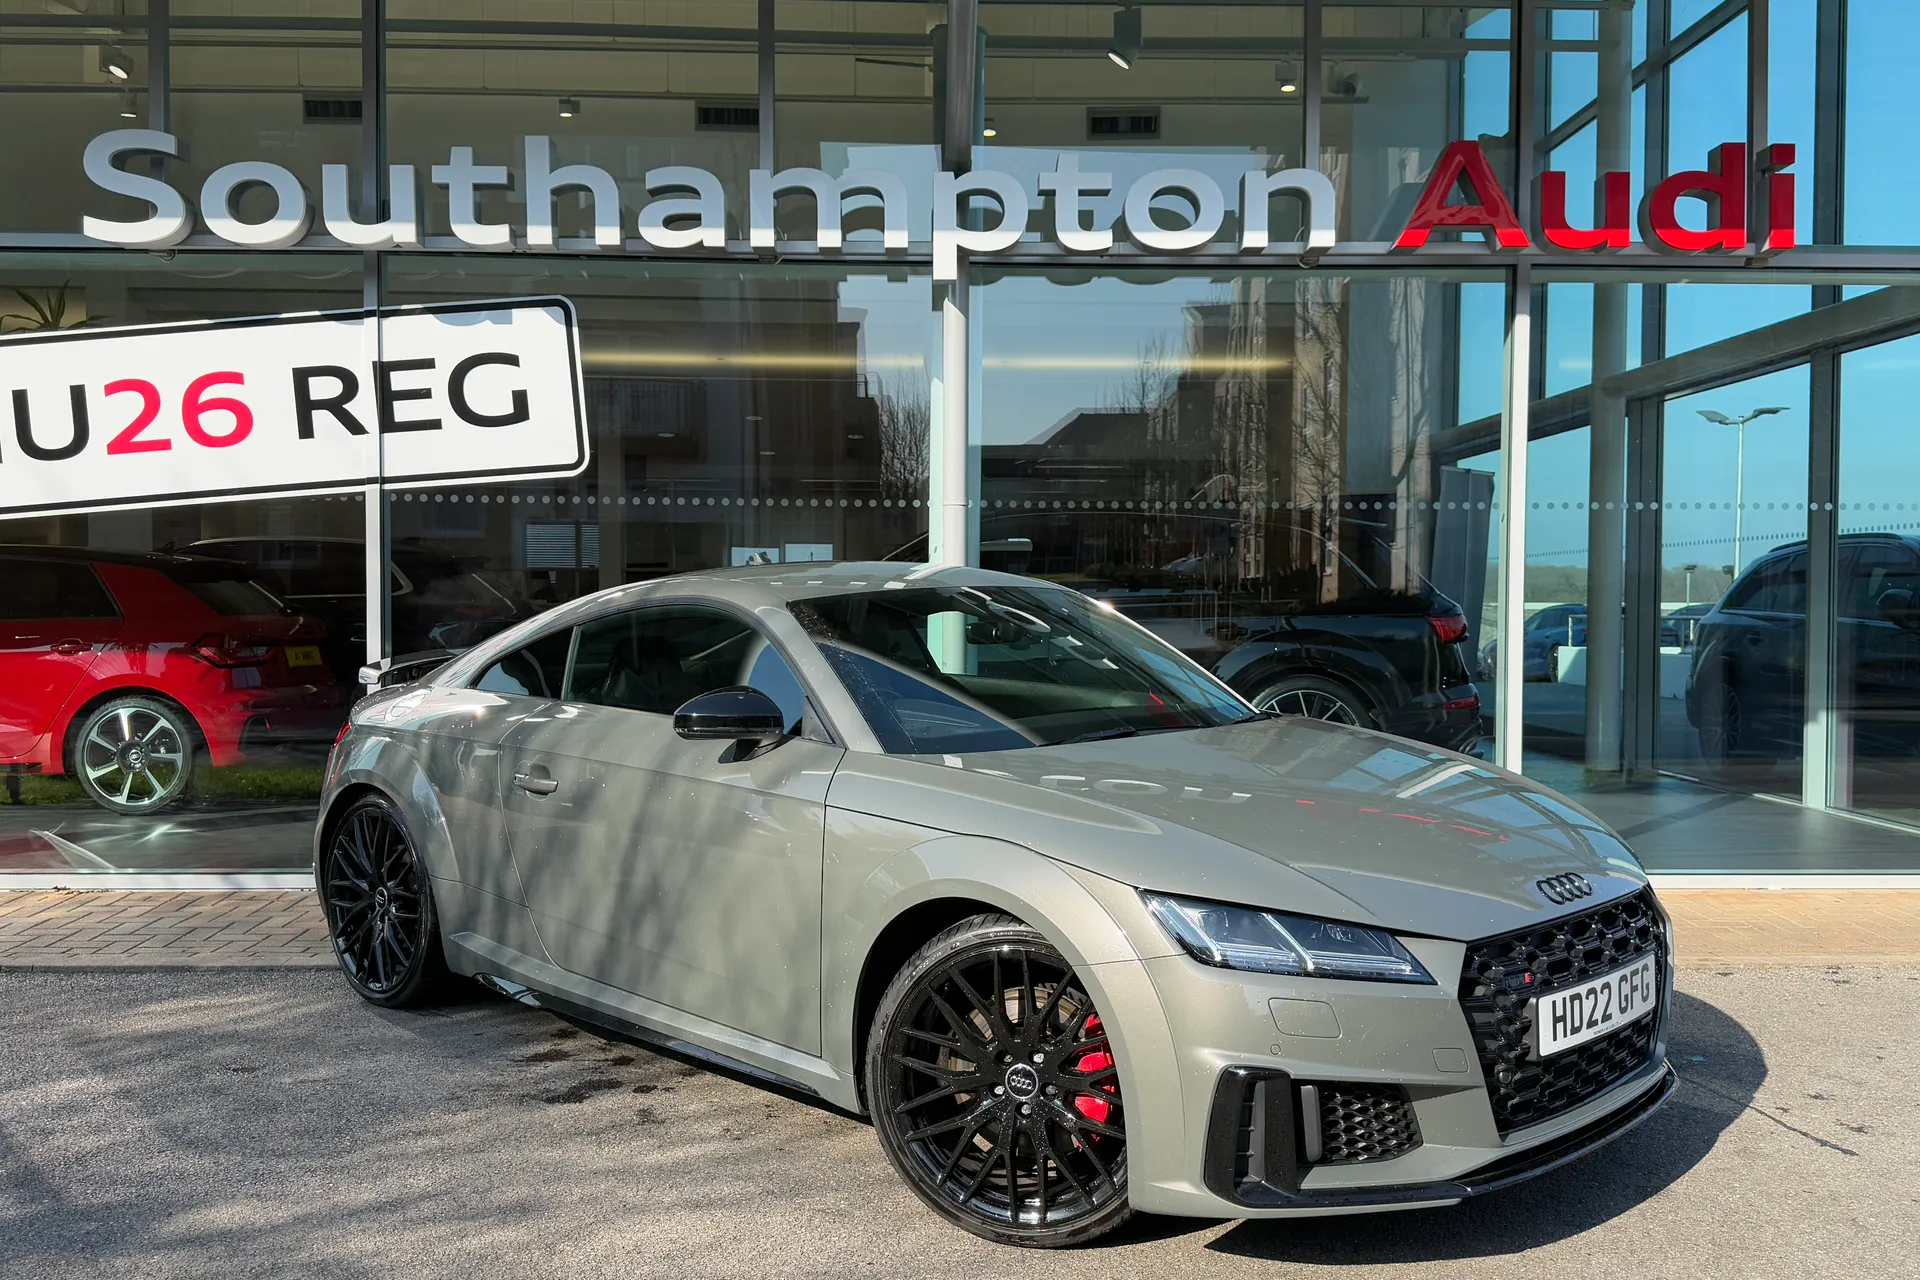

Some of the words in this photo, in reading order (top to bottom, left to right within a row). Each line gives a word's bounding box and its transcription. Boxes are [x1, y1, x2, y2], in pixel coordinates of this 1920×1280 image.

[82, 129, 1337, 284] Southampton
[1390, 140, 1796, 255] Audi
[0, 370, 254, 464] U26
[292, 352, 530, 440] REG
[1551, 981, 1613, 1042] HD22
[1618, 963, 1650, 1015] GFG
